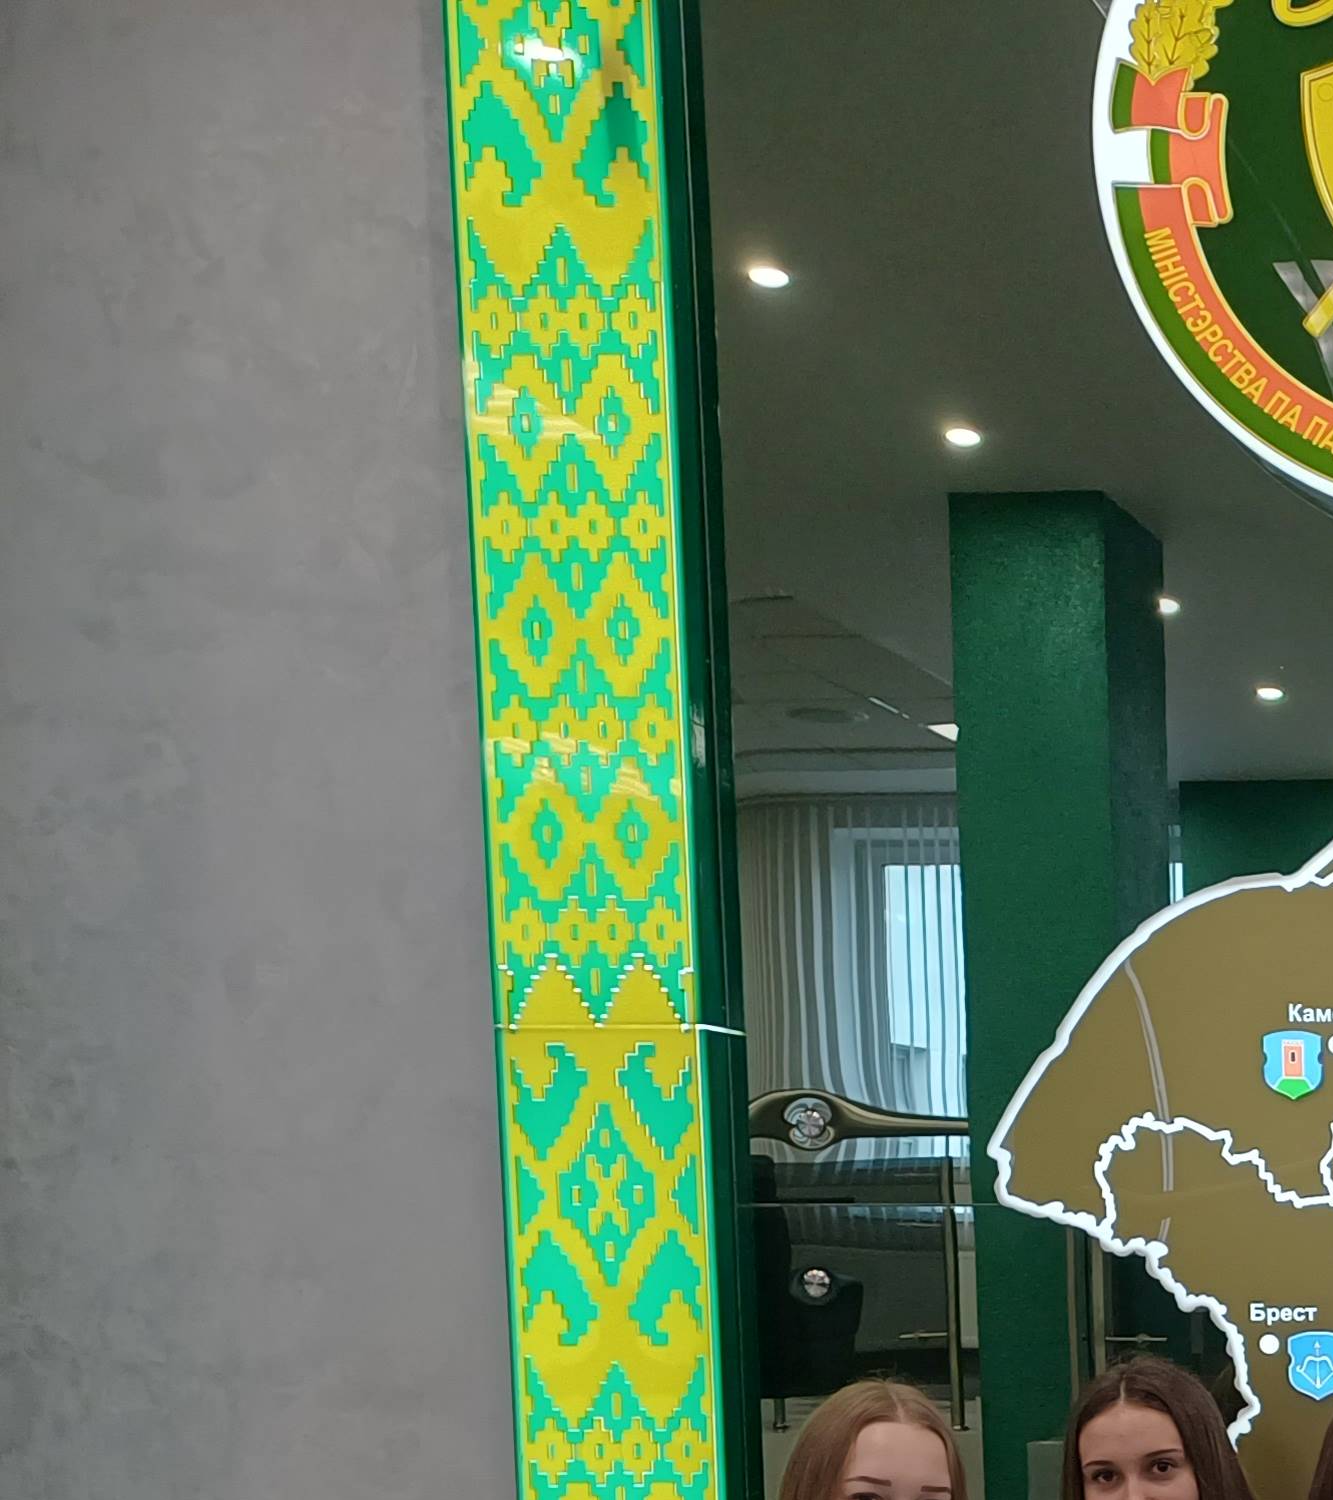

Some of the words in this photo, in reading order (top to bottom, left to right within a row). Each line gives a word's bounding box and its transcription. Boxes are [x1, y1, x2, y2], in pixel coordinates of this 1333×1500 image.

[1143, 226, 1269, 407] МІНІСТЭРСТВА
[1262, 390, 1304, 433] ПА
[1249, 1303, 1318, 1326] Брест
